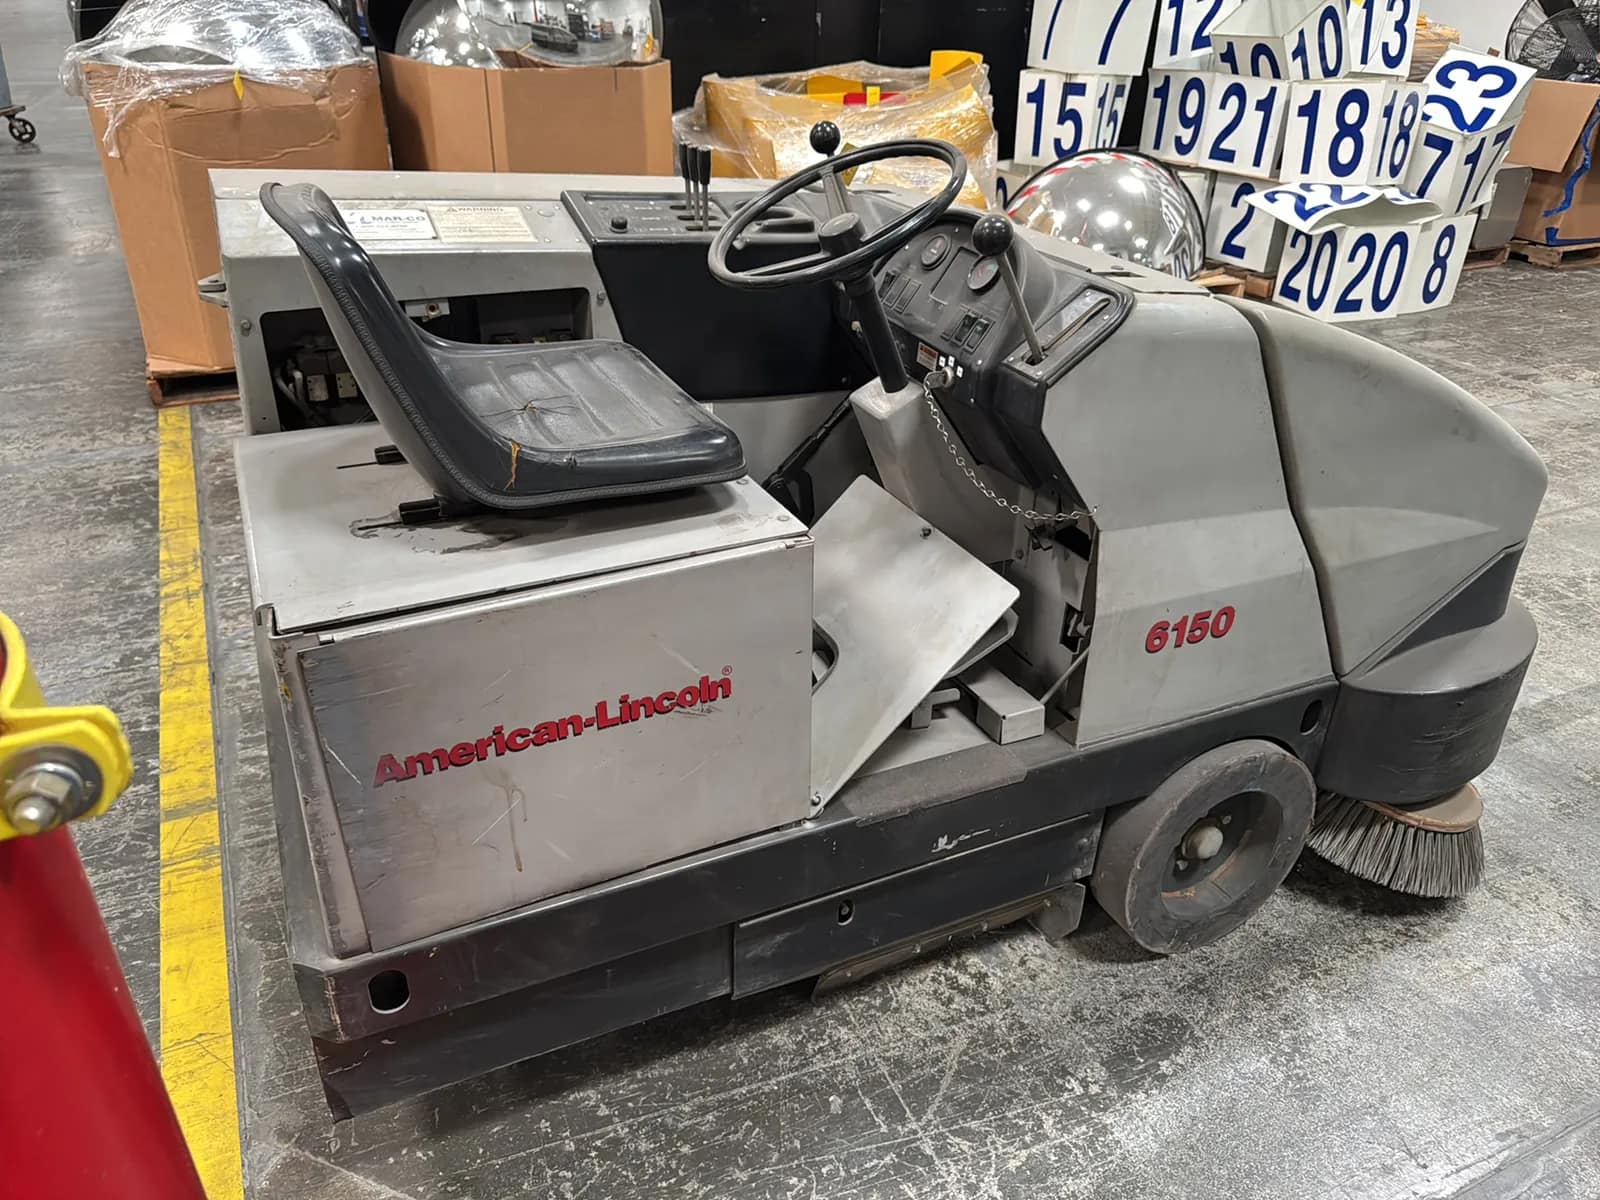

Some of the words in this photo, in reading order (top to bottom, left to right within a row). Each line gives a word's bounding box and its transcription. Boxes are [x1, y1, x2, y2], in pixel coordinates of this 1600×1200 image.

[1168, 0, 1222, 56] 12
[1292, 5, 1343, 81] 10
[1359, 0, 1411, 69] 13
[1026, 78, 1087, 159] 15
[1096, 81, 1127, 150] 15
[1152, 75, 1205, 157] 19
[1208, 82, 1278, 168] 21
[1297, 88, 1370, 178] 18
[1376, 90, 1421, 179] 18
[1455, 125, 1516, 215] 17
[1279, 229, 1337, 312] 20
[1334, 231, 1409, 313] 20
[1422, 224, 1456, 304] 8
[1145, 605, 1236, 654] 6150
